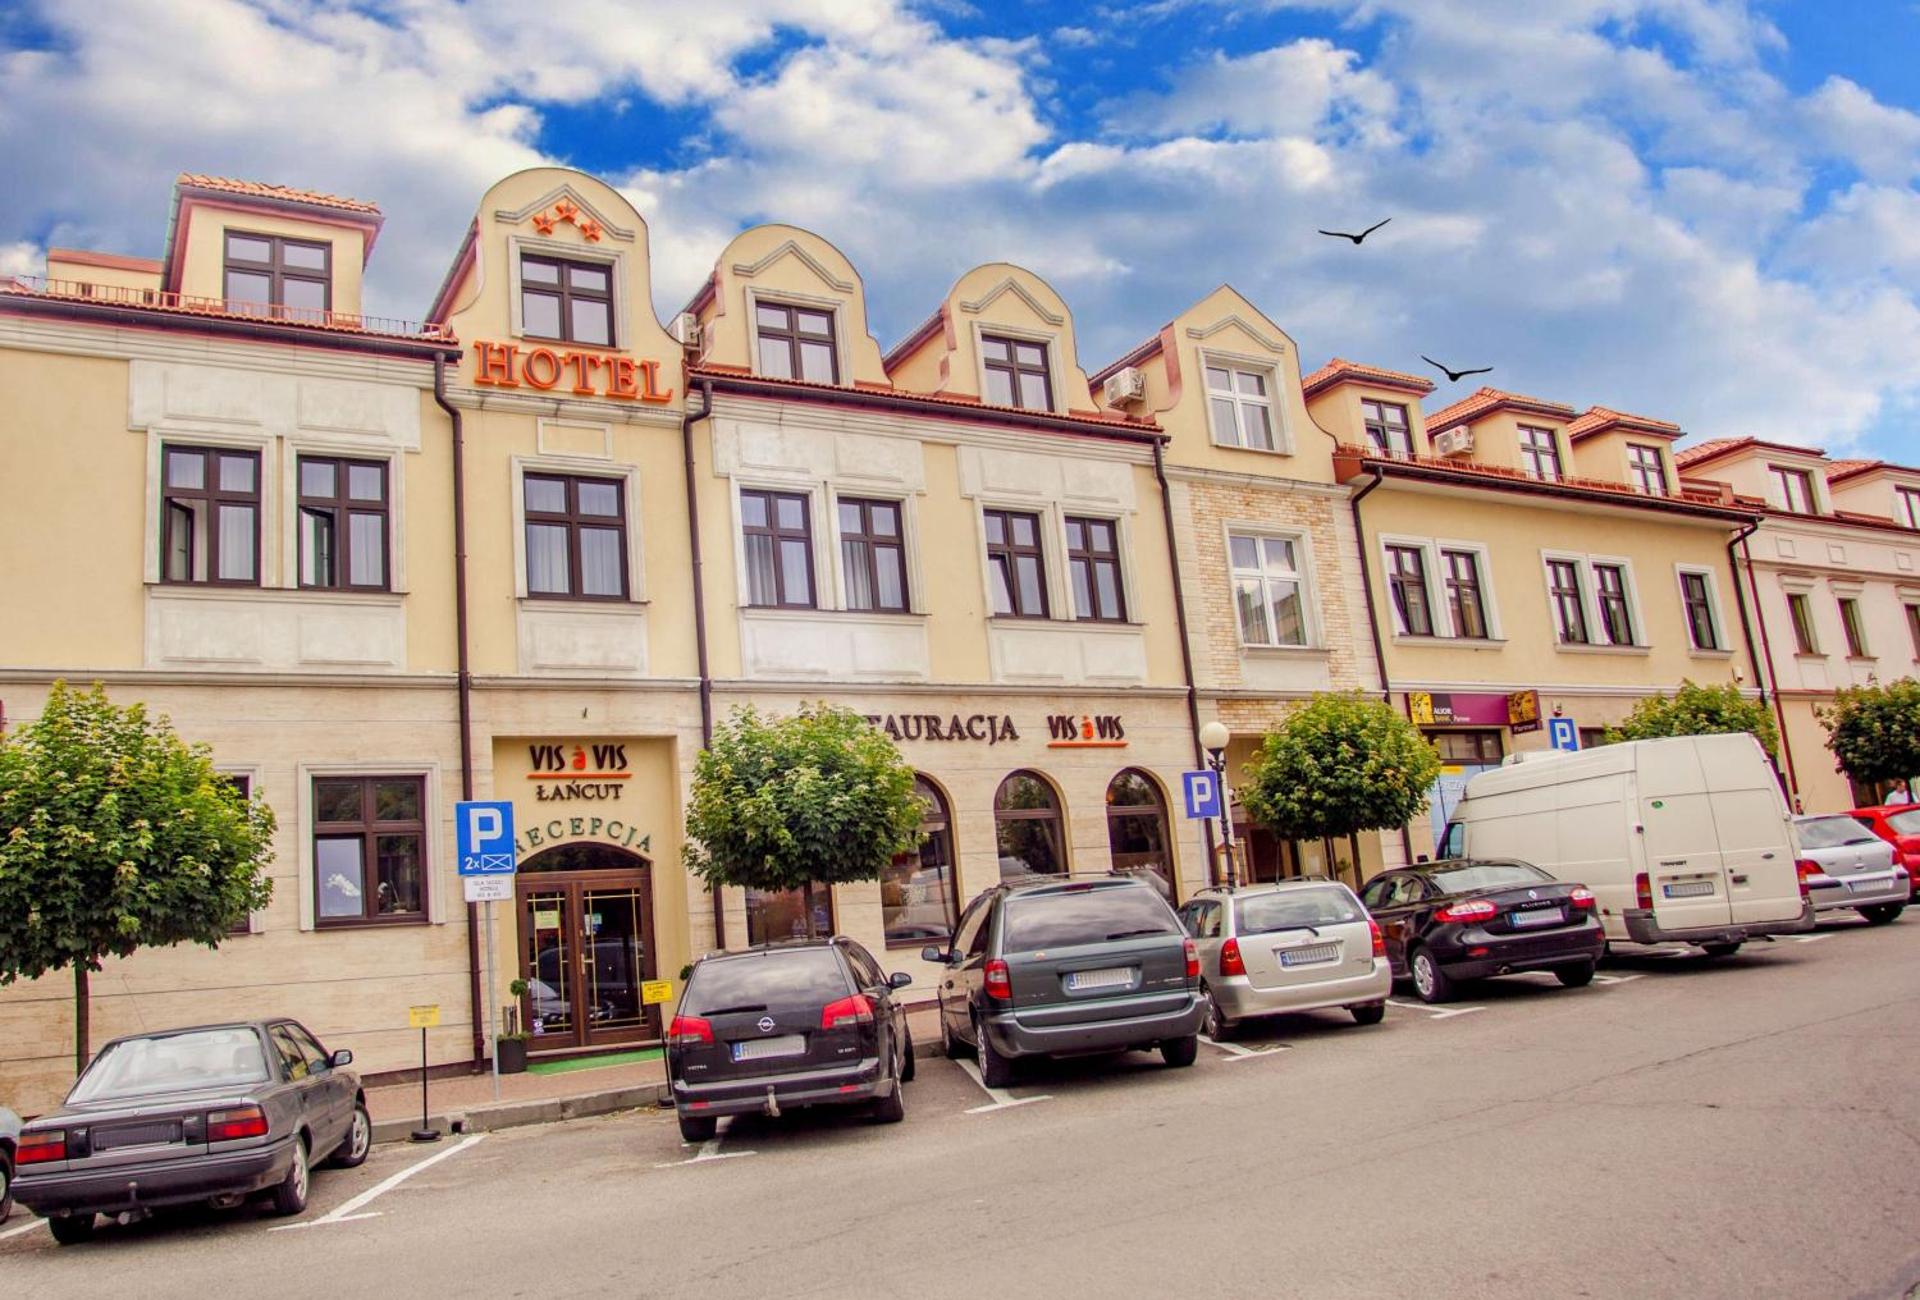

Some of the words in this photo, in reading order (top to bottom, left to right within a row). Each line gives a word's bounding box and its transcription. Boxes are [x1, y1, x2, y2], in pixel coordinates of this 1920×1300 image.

[474, 340, 673, 403] HOTEL
[863, 713, 1020, 746] TAURACJA
[1047, 715, 1078, 740] VIS
[1095, 715, 1125, 740] VIS
[1555, 722, 1571, 750] P
[529, 744, 565, 771] VIS
[592, 744, 627, 770] VIS
[536, 778, 624, 801] ŁAŃCUT
[1191, 776, 1212, 814] P
[469, 808, 503, 854] P
[464, 856, 480, 870] 2x
